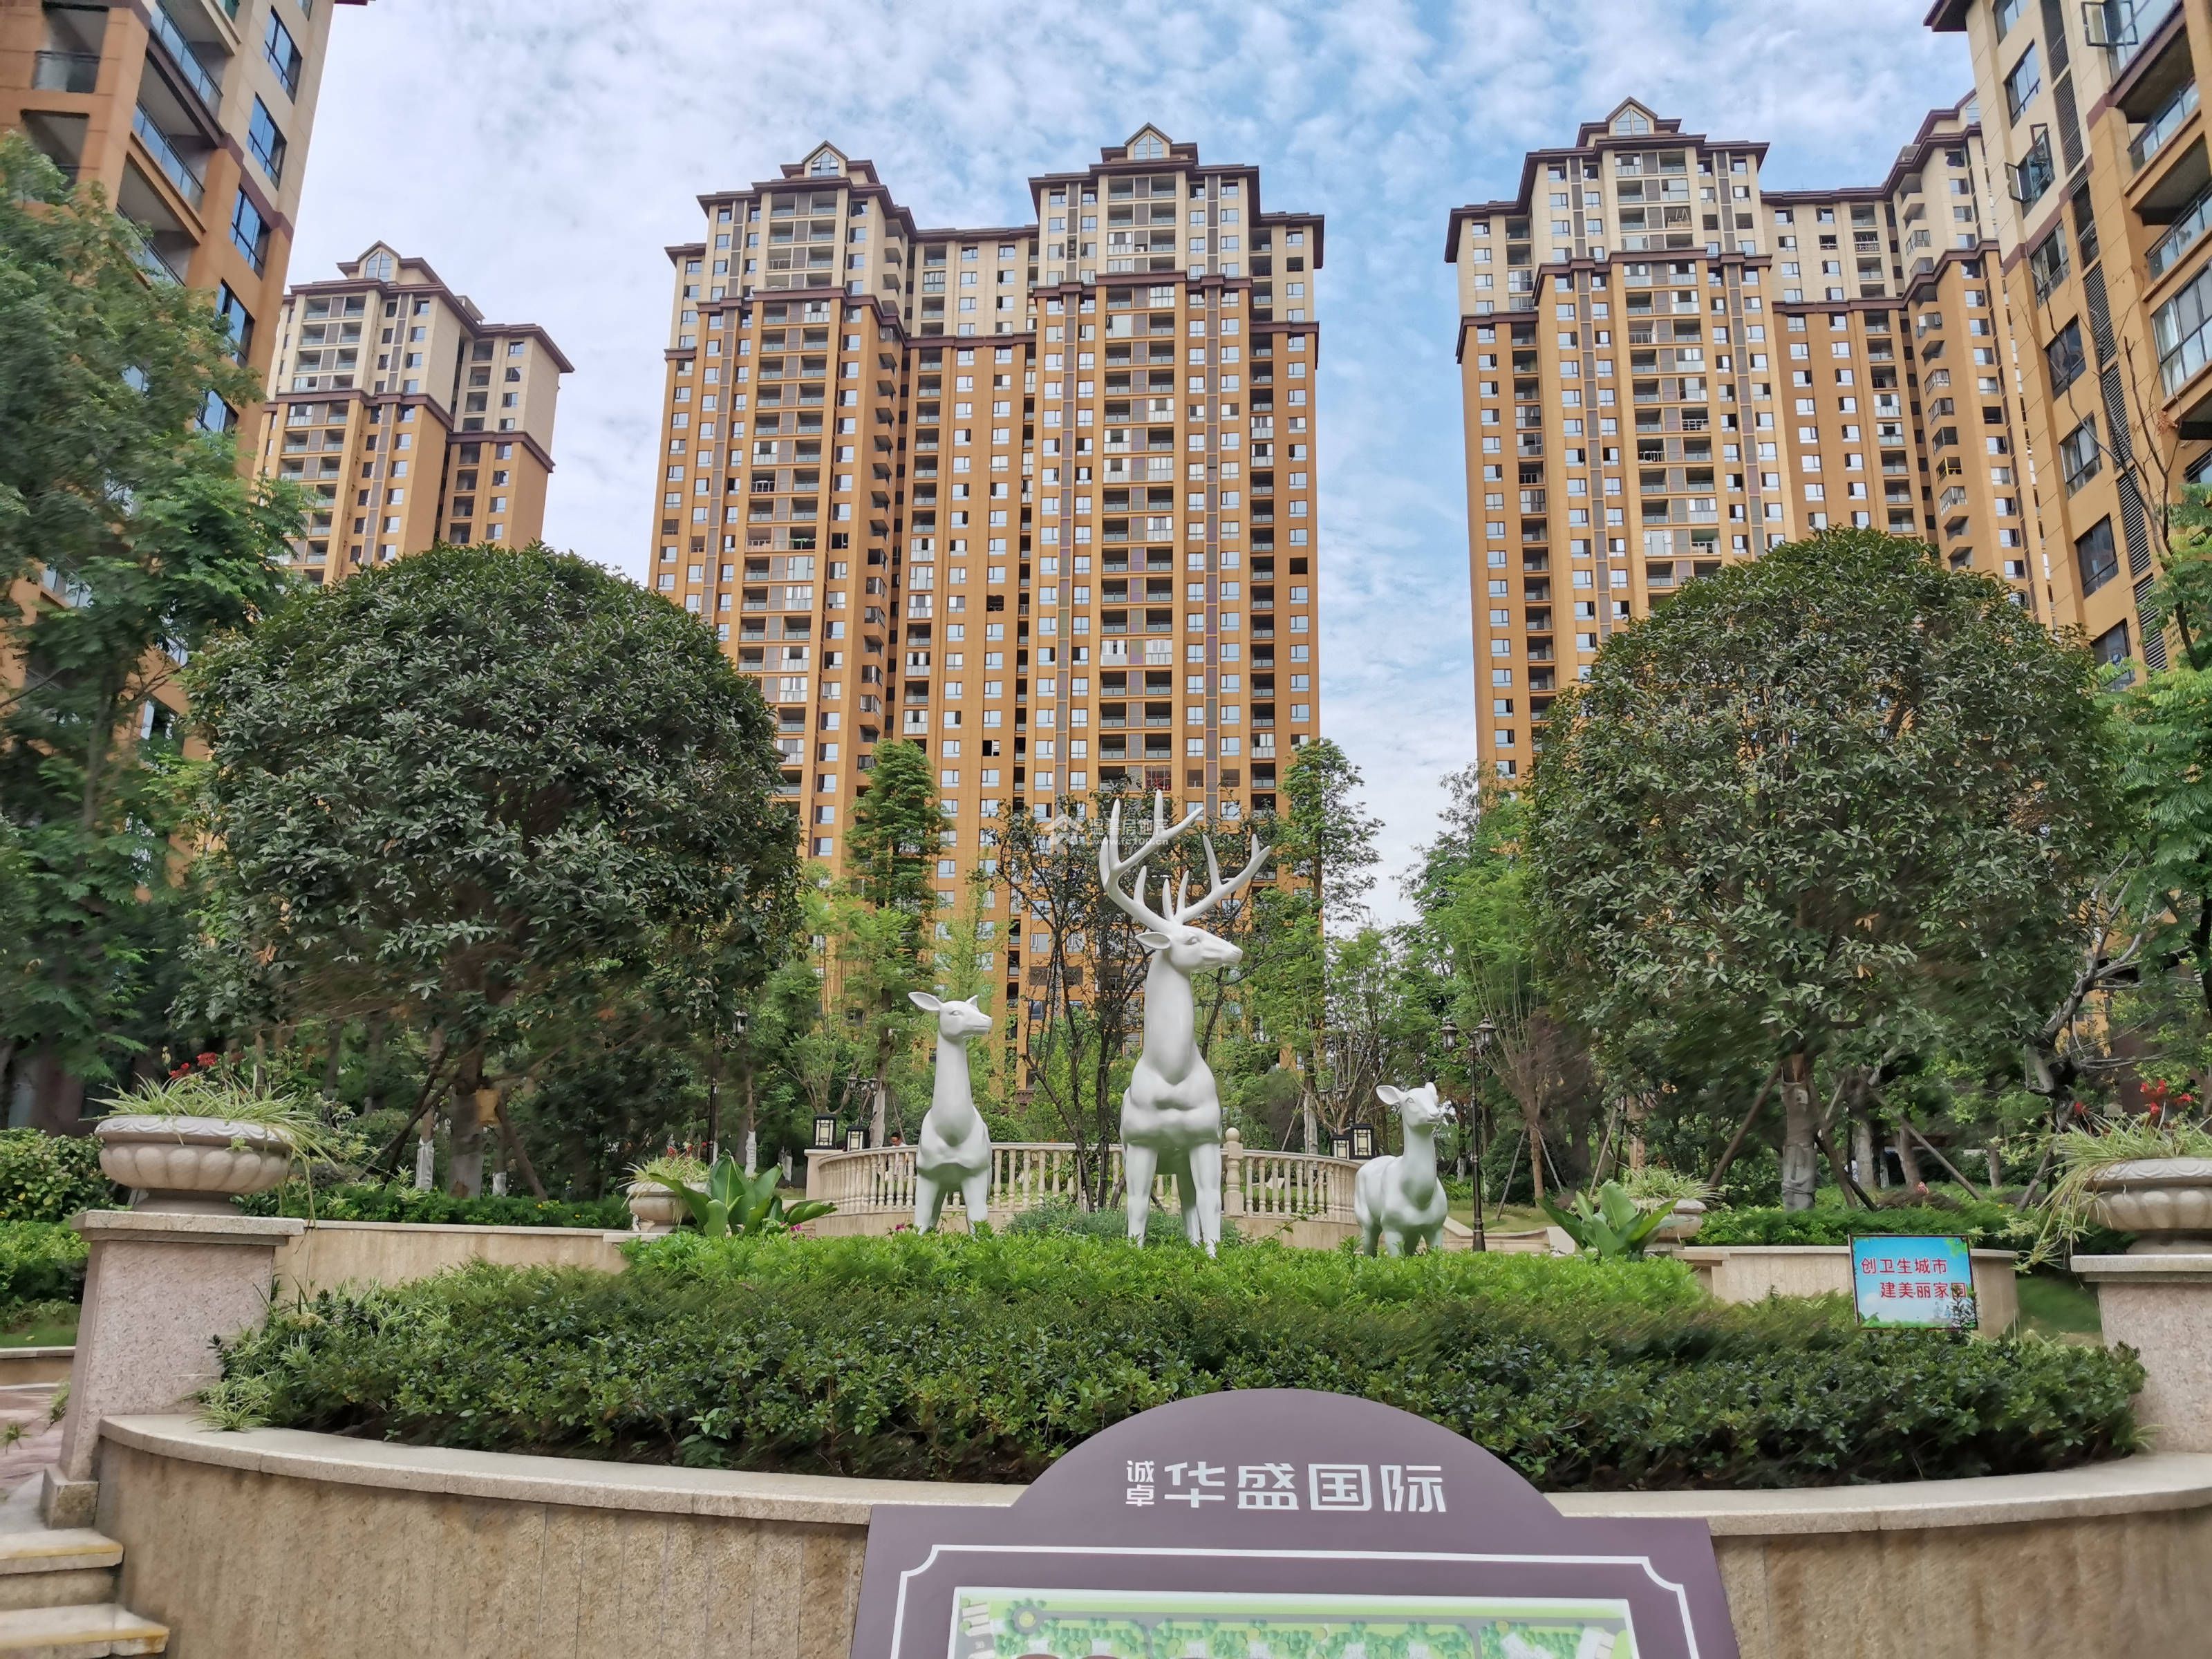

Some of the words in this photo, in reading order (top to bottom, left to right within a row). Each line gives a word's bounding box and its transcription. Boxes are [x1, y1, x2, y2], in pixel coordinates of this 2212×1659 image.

[1861, 1257, 1947, 1275] 创卫生城市
[1126, 1460, 1155, 1507] 诚卓
[1164, 1461, 1447, 1512] 华盛国际
